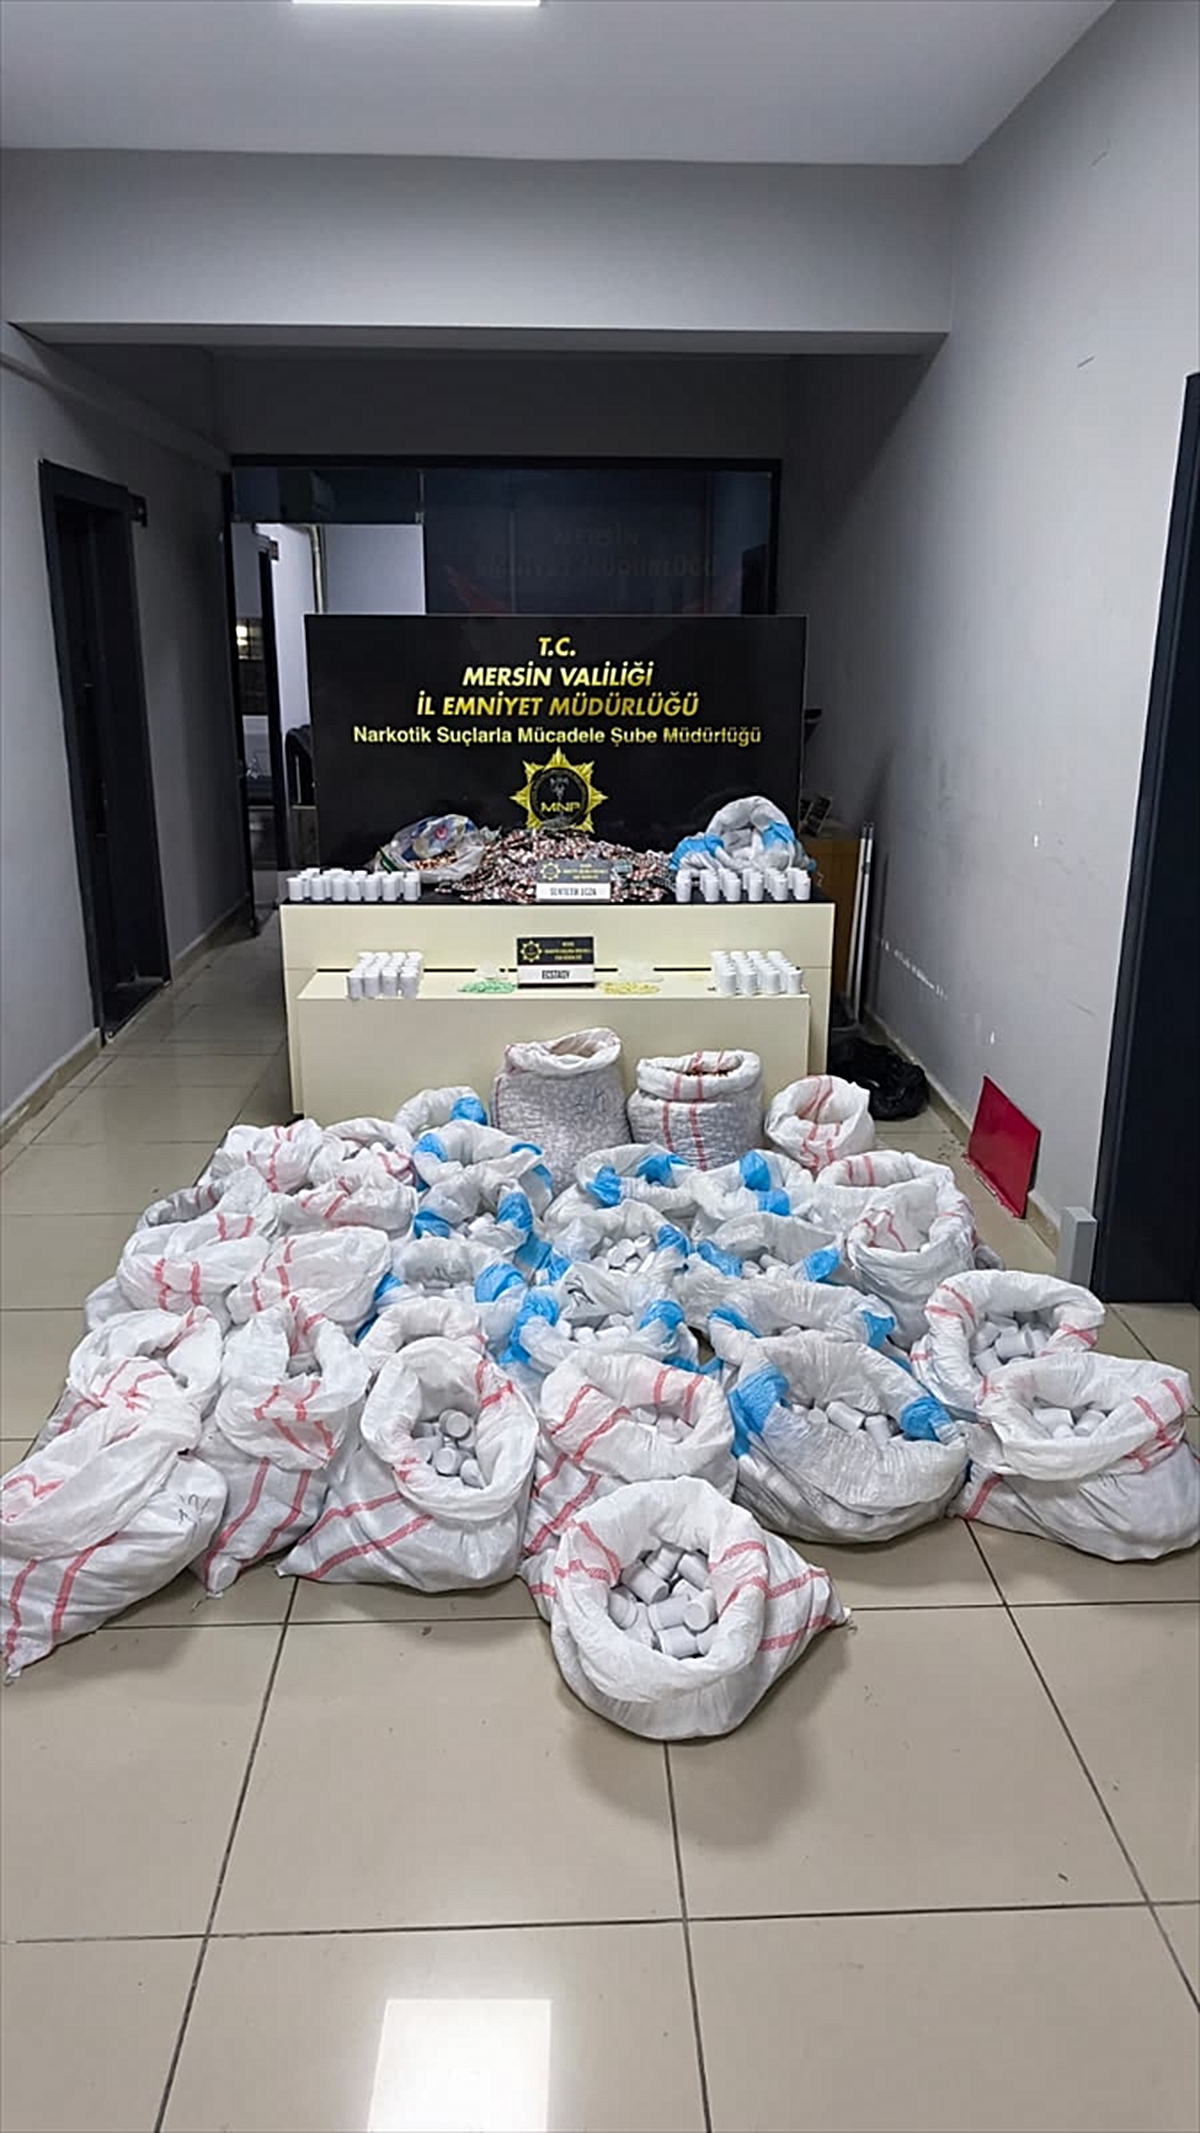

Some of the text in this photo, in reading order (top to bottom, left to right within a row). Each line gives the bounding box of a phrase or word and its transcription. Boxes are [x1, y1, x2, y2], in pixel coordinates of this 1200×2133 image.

[538, 637, 576, 656] T.C.
[462, 660, 655, 686] MERSİN VALİLİĞİ
[416, 690, 699, 717] İL EMNİYET MÜDÜRLÜĞÜ
[353, 725, 762, 748] Narkotik Suçlarla Mücadele Şube Müdürlüğü
[540, 801, 581, 812] MNP
